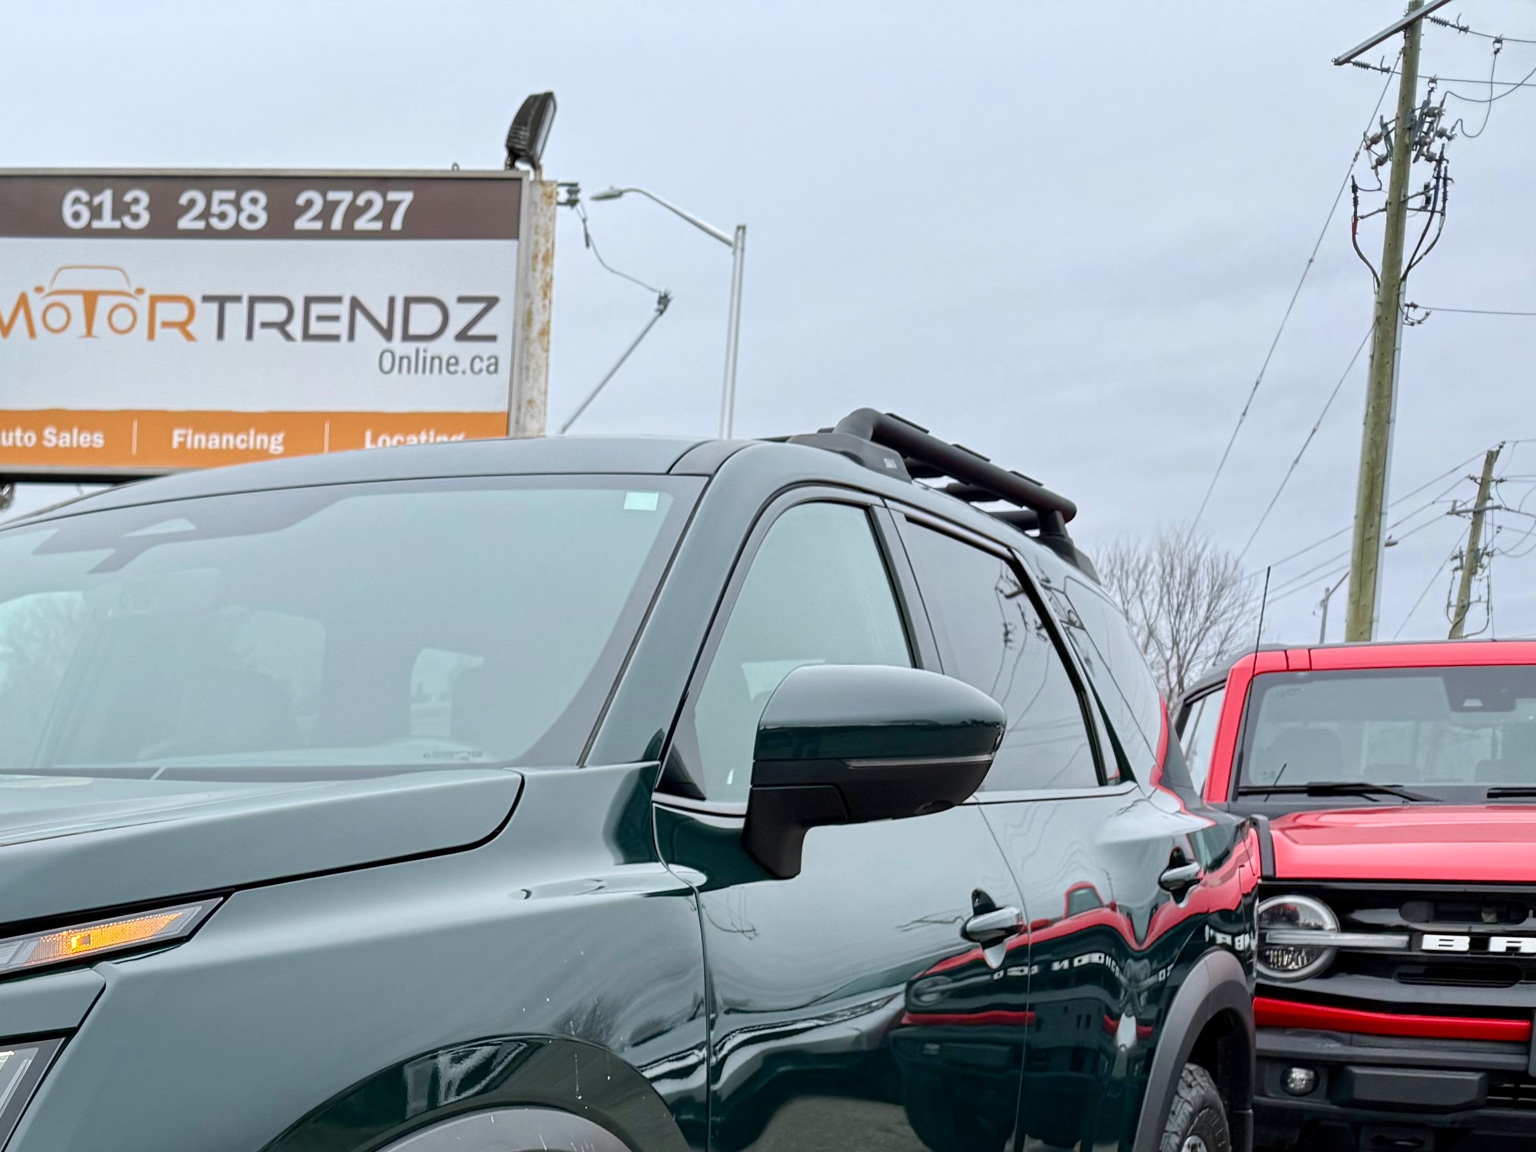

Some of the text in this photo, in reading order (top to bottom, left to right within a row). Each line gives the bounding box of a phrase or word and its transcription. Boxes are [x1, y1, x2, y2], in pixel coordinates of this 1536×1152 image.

[62, 188, 415, 231] 613 258 2727
[377, 348, 500, 376] Online.ca
[42, 425, 105, 448] Sales
[171, 427, 285, 455] Financing
